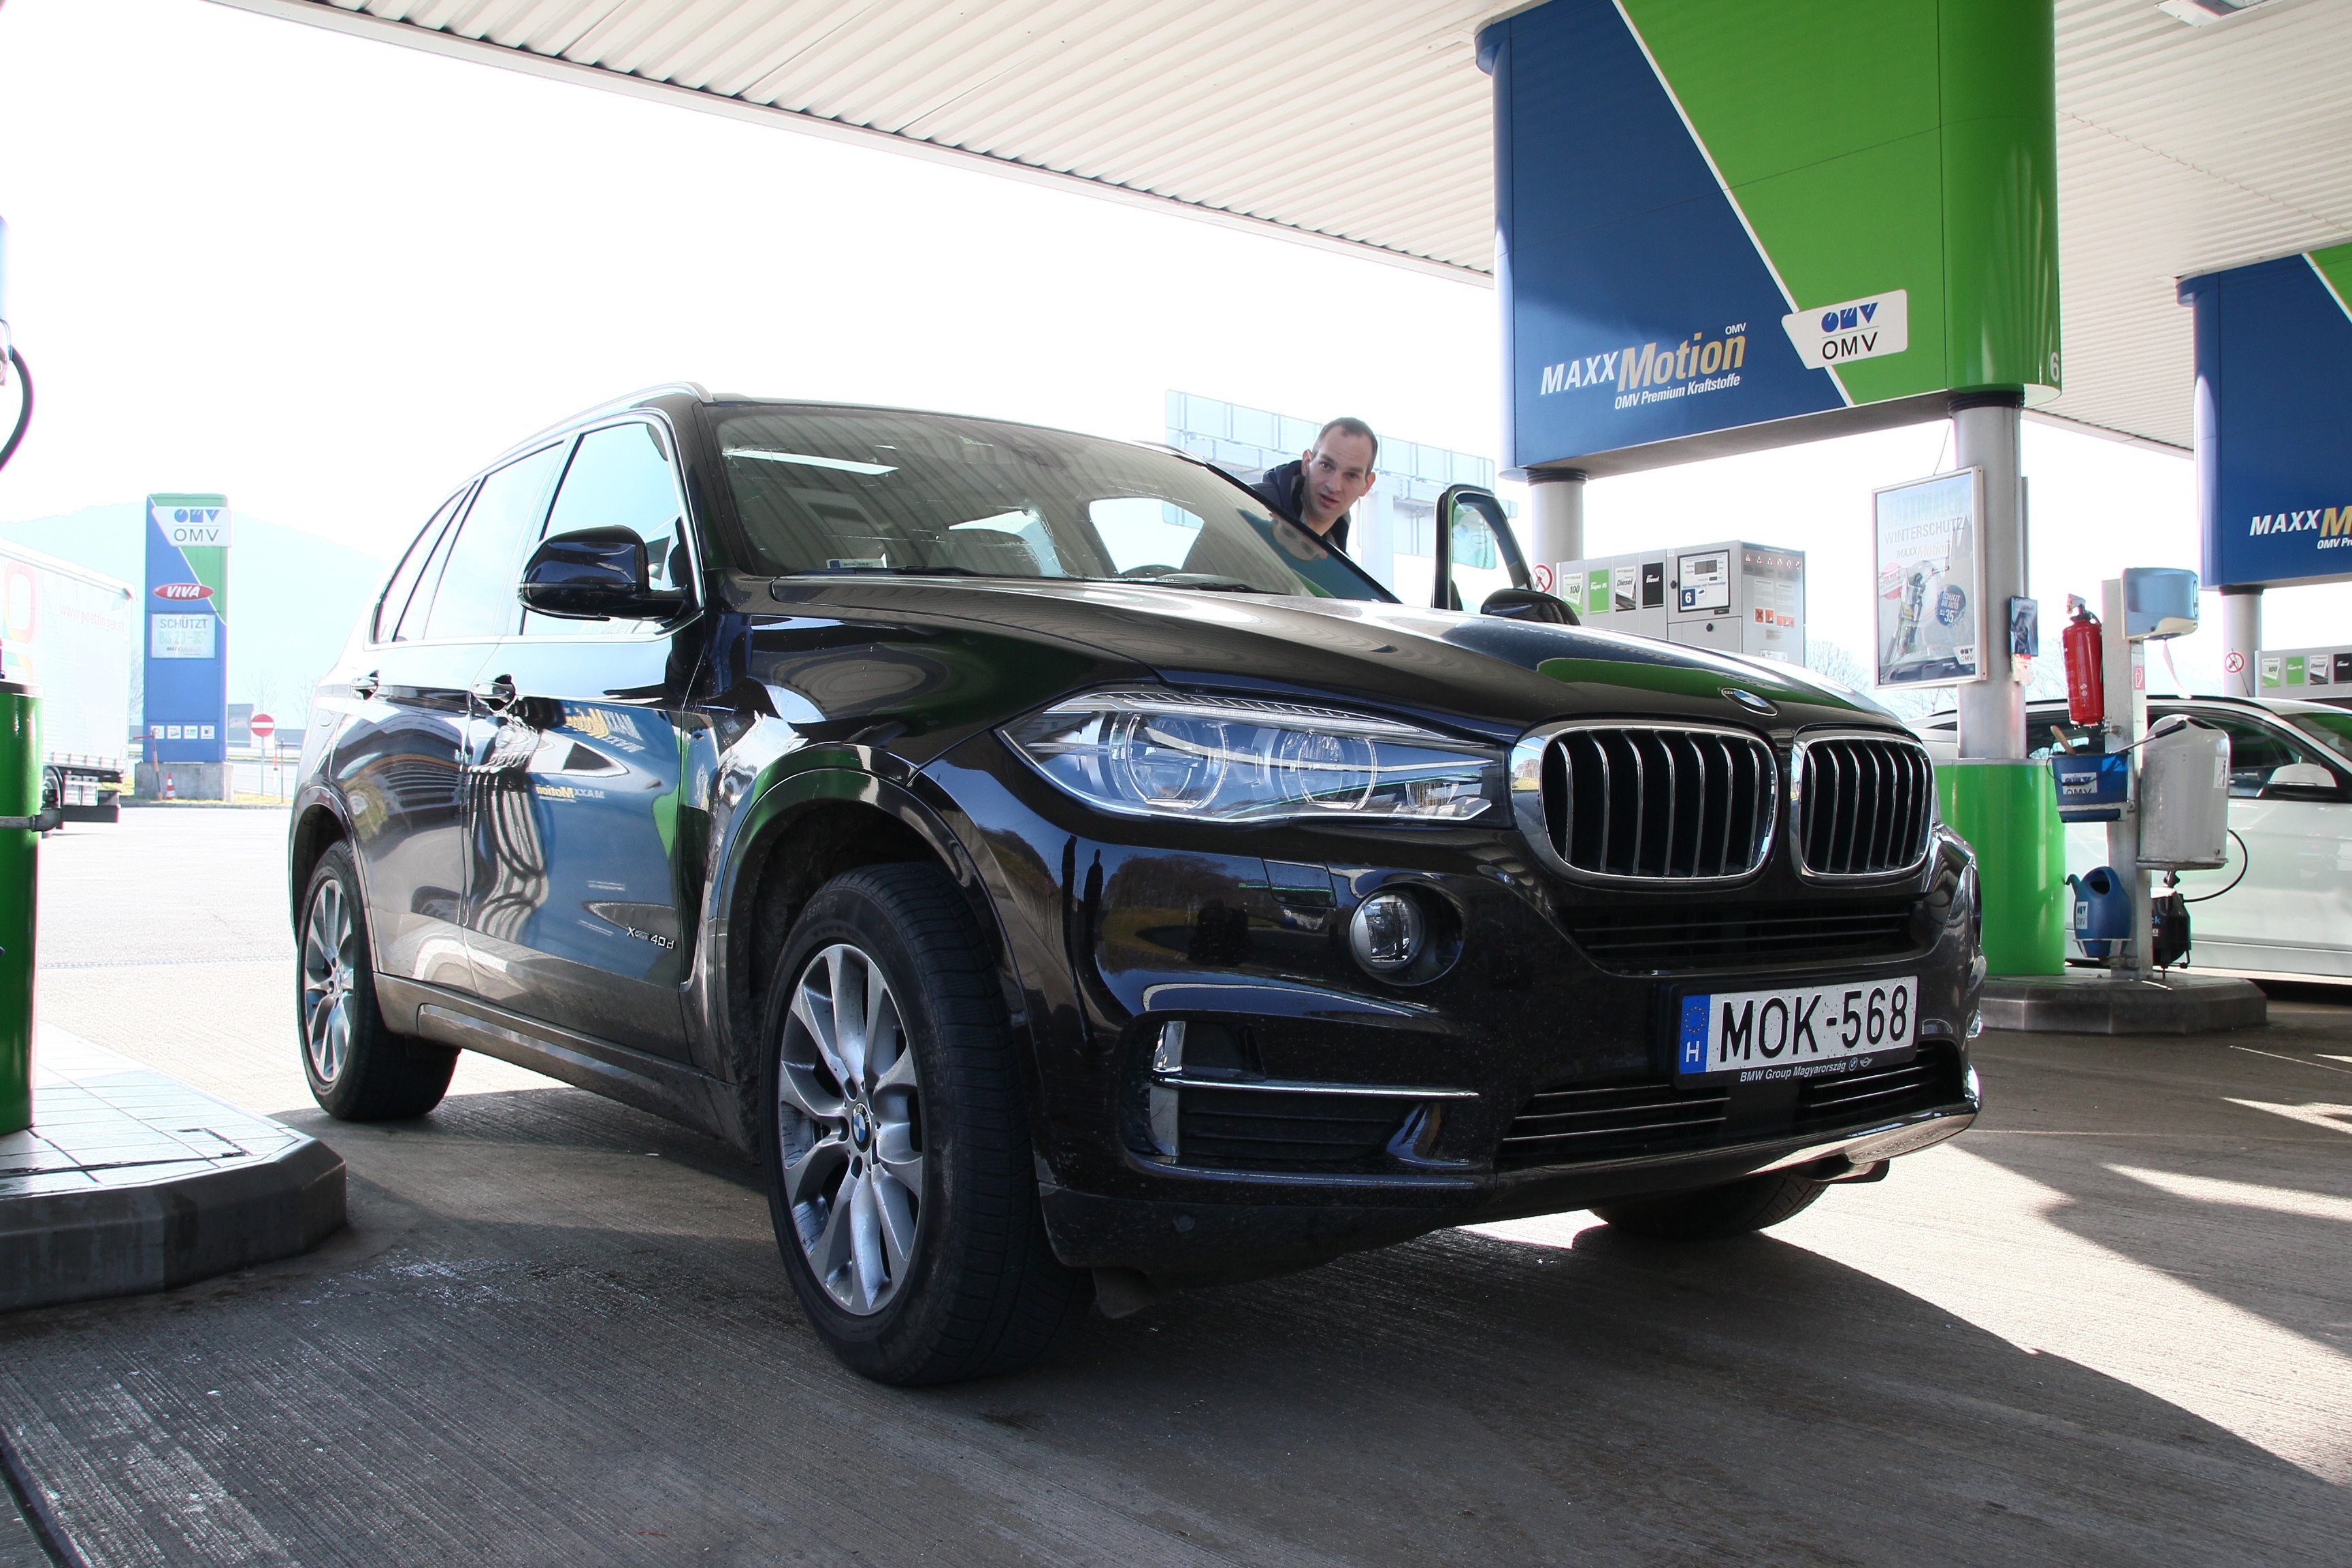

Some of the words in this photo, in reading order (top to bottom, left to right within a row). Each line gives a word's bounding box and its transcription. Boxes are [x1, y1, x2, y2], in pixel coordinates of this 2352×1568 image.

[1725, 323, 1746, 335] OMV
[1822, 331, 1878, 368] OMV
[2050, 351, 2059, 382] 6
[1614, 394, 1642, 410] OMV
[1641, 387, 1685, 405] Premium
[1687, 372, 1741, 395] Kraftstoffe
[174, 528, 219, 542] OMV
[1883, 517, 1964, 545] WINTERSCHUTZ
[2317, 538, 2341, 550] OMV
[1617, 578, 1633, 587] Diesel
[1646, 576, 1659, 584] Diesel
[167, 585, 201, 598] VIVA
[1570, 585, 1580, 594] 100
[1684, 592, 1692, 604] 6
[60, 602, 125, 634] www.poettinger.at
[160, 616, 208, 629] SCHÜTZT
[1719, 984, 1908, 1063] MOK-568
[1686, 1041, 1700, 1063] H
[1740, 1070, 1764, 1082] BMW
[1765, 1069, 1791, 1080] Group
[1793, 1060, 1846, 1077] Magyarország
